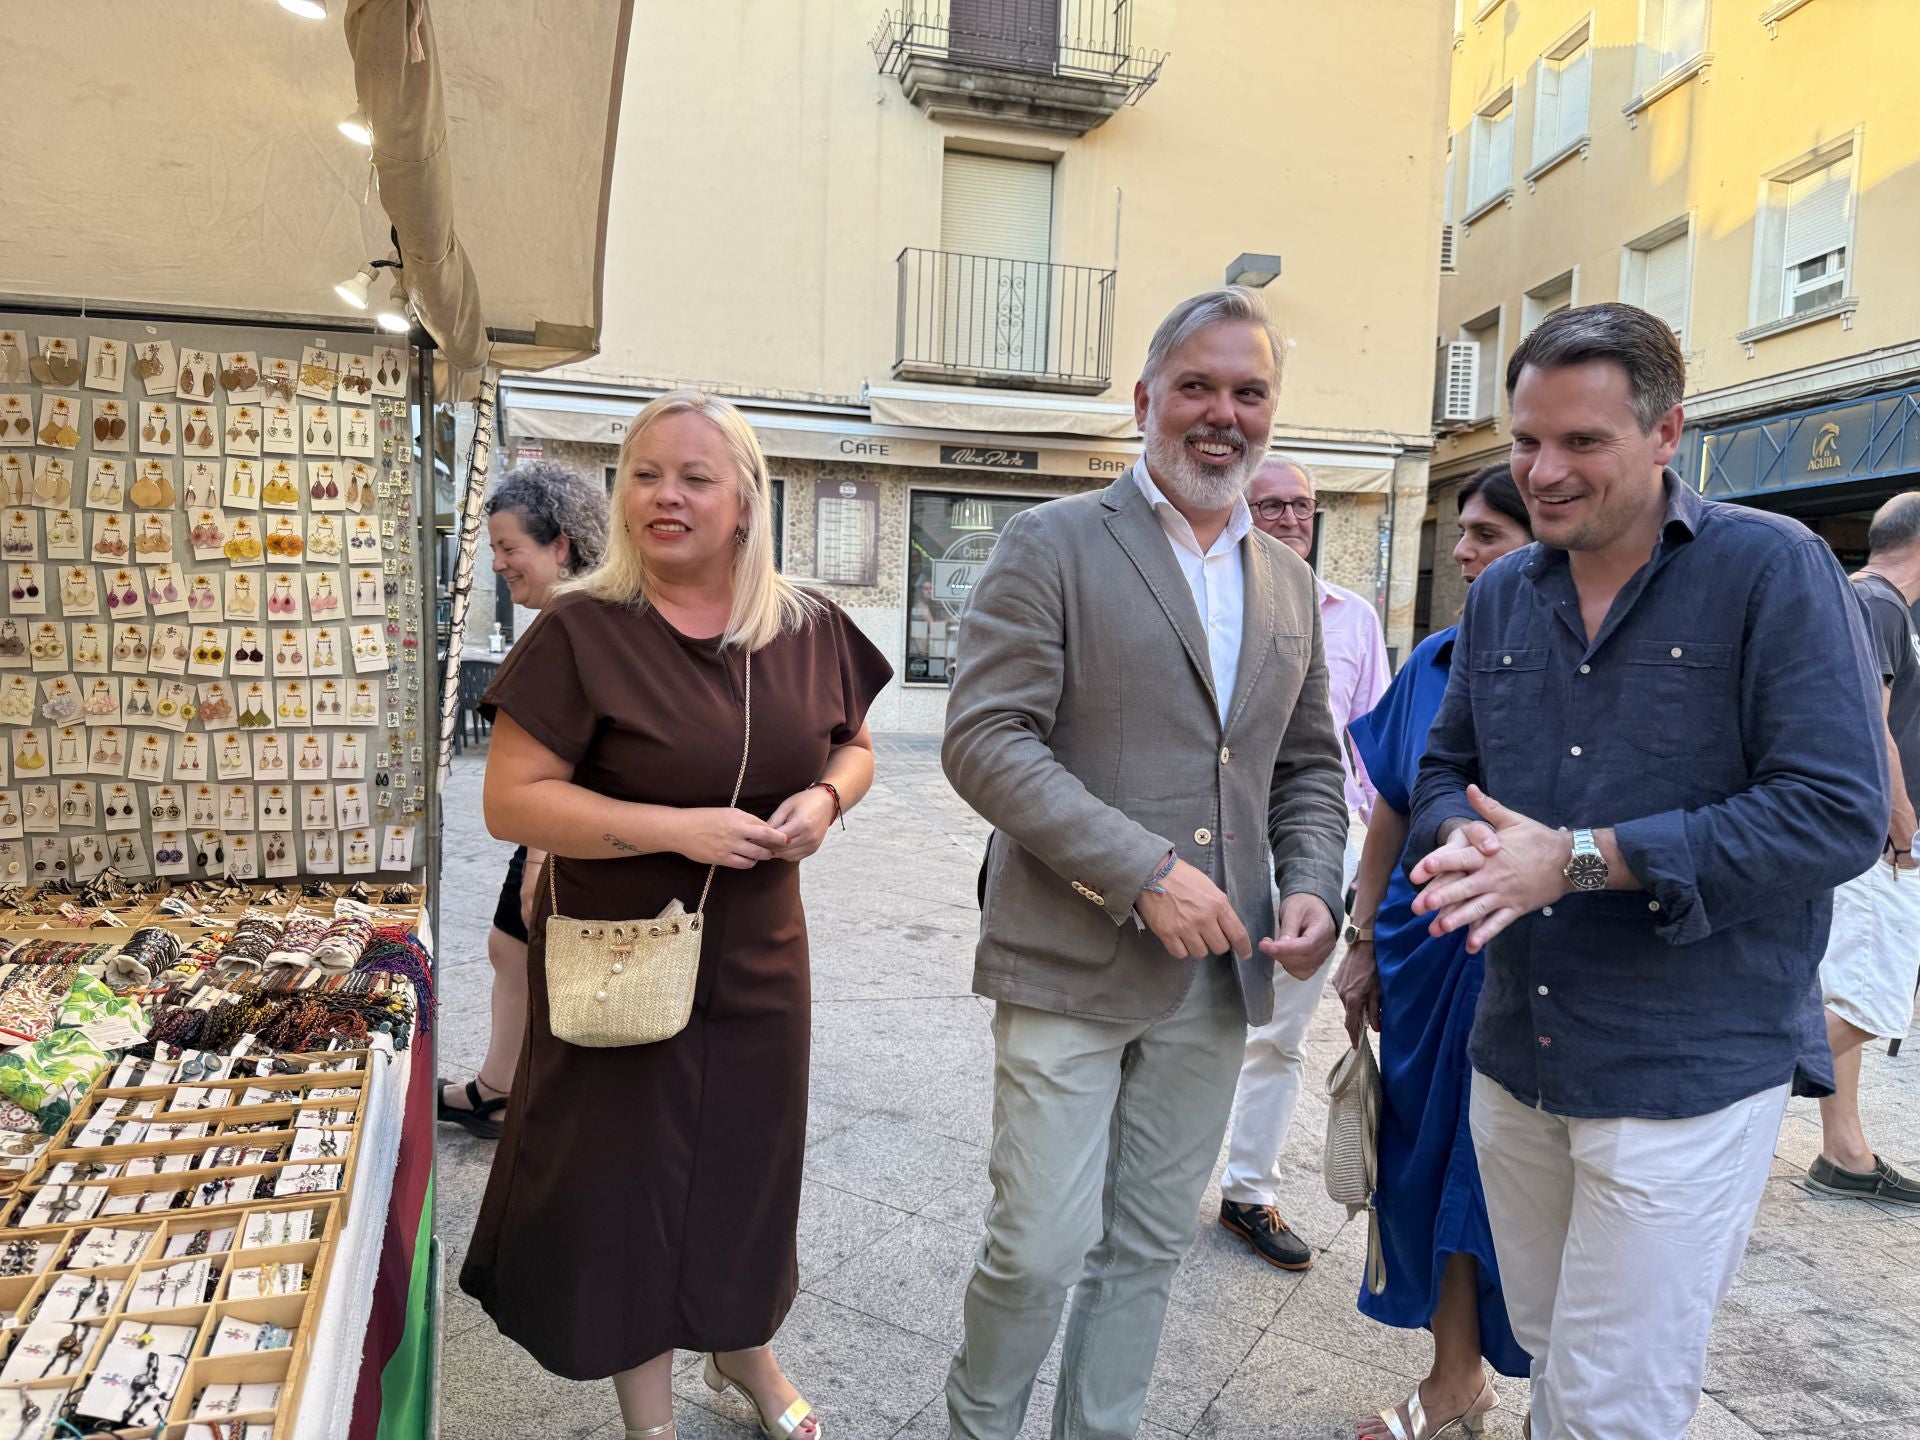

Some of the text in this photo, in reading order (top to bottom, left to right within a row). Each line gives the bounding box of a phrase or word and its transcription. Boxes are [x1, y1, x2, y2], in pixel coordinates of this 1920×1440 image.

[839, 439, 890, 456] CAFE
[985, 450, 1025, 467] Plata
[1088, 457, 1126, 473] BAR
